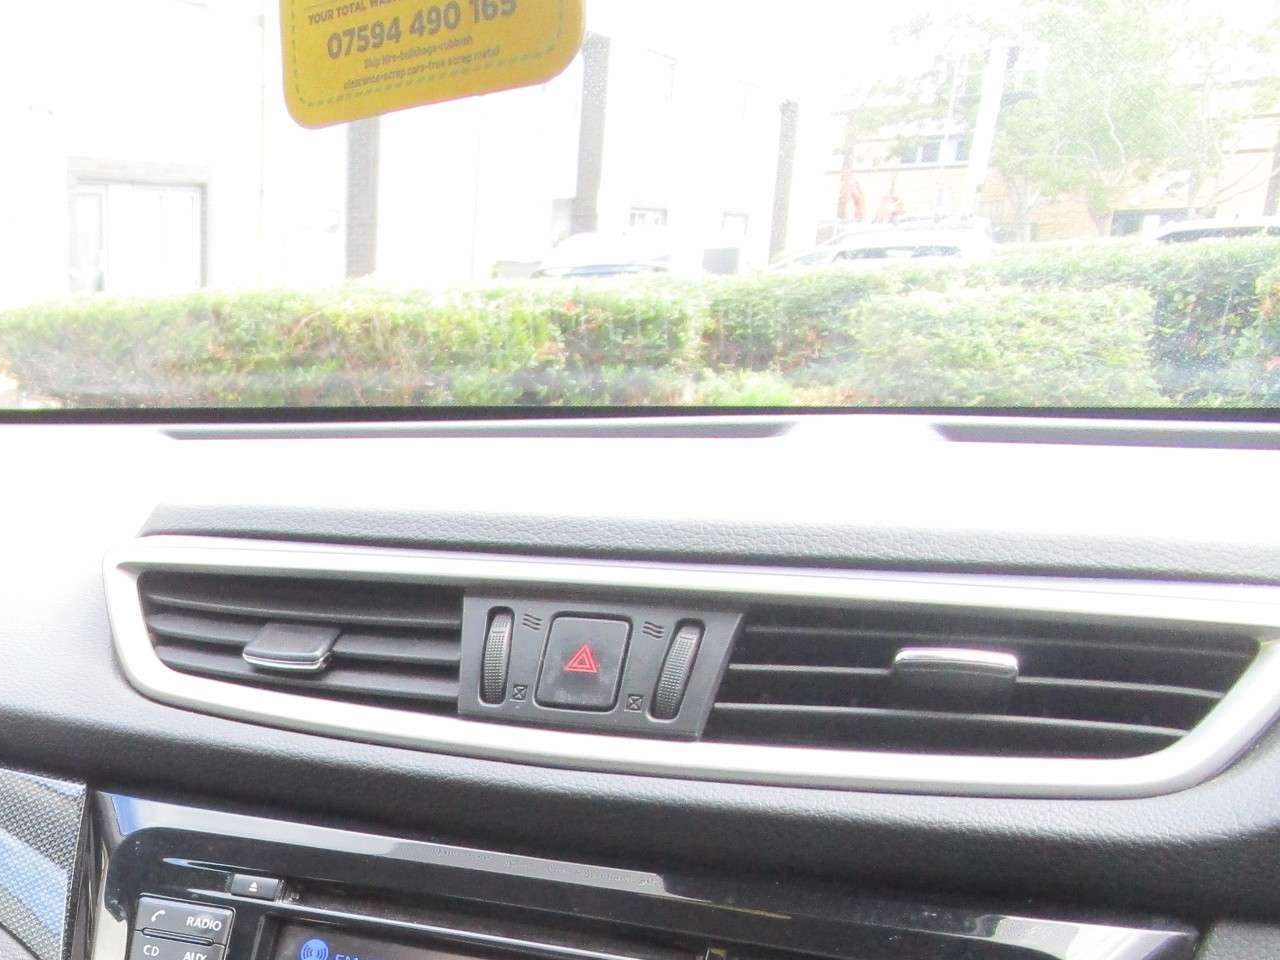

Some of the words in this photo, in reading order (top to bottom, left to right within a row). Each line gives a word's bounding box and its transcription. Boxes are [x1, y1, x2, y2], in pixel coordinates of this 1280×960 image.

[308, 9, 334, 25] YOUR
[336, 1, 367, 17] TOTAL
[327, 16, 401, 60] 07594
[409, 1, 461, 36] 490
[186, 916, 221, 931] RADIO
[143, 945, 159, 956] CD
